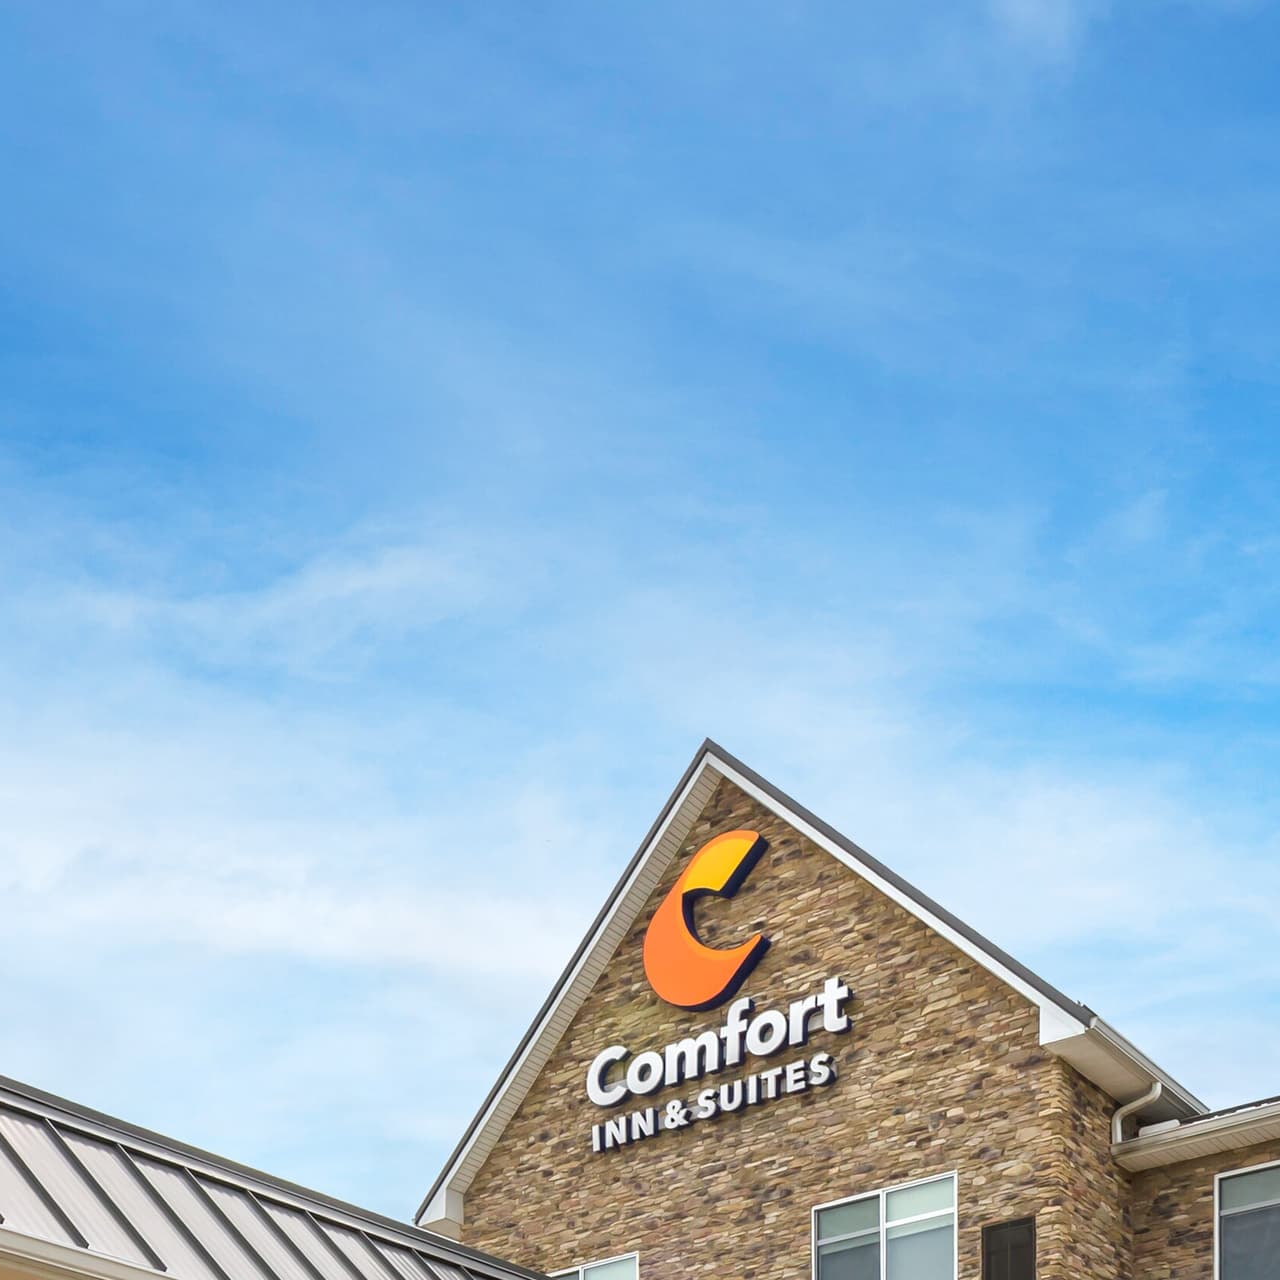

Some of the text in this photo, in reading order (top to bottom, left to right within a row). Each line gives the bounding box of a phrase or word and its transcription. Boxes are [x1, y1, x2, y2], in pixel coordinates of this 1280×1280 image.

[586, 976, 851, 1107] Comfort
[591, 1053, 835, 1152] INN & SUITES
